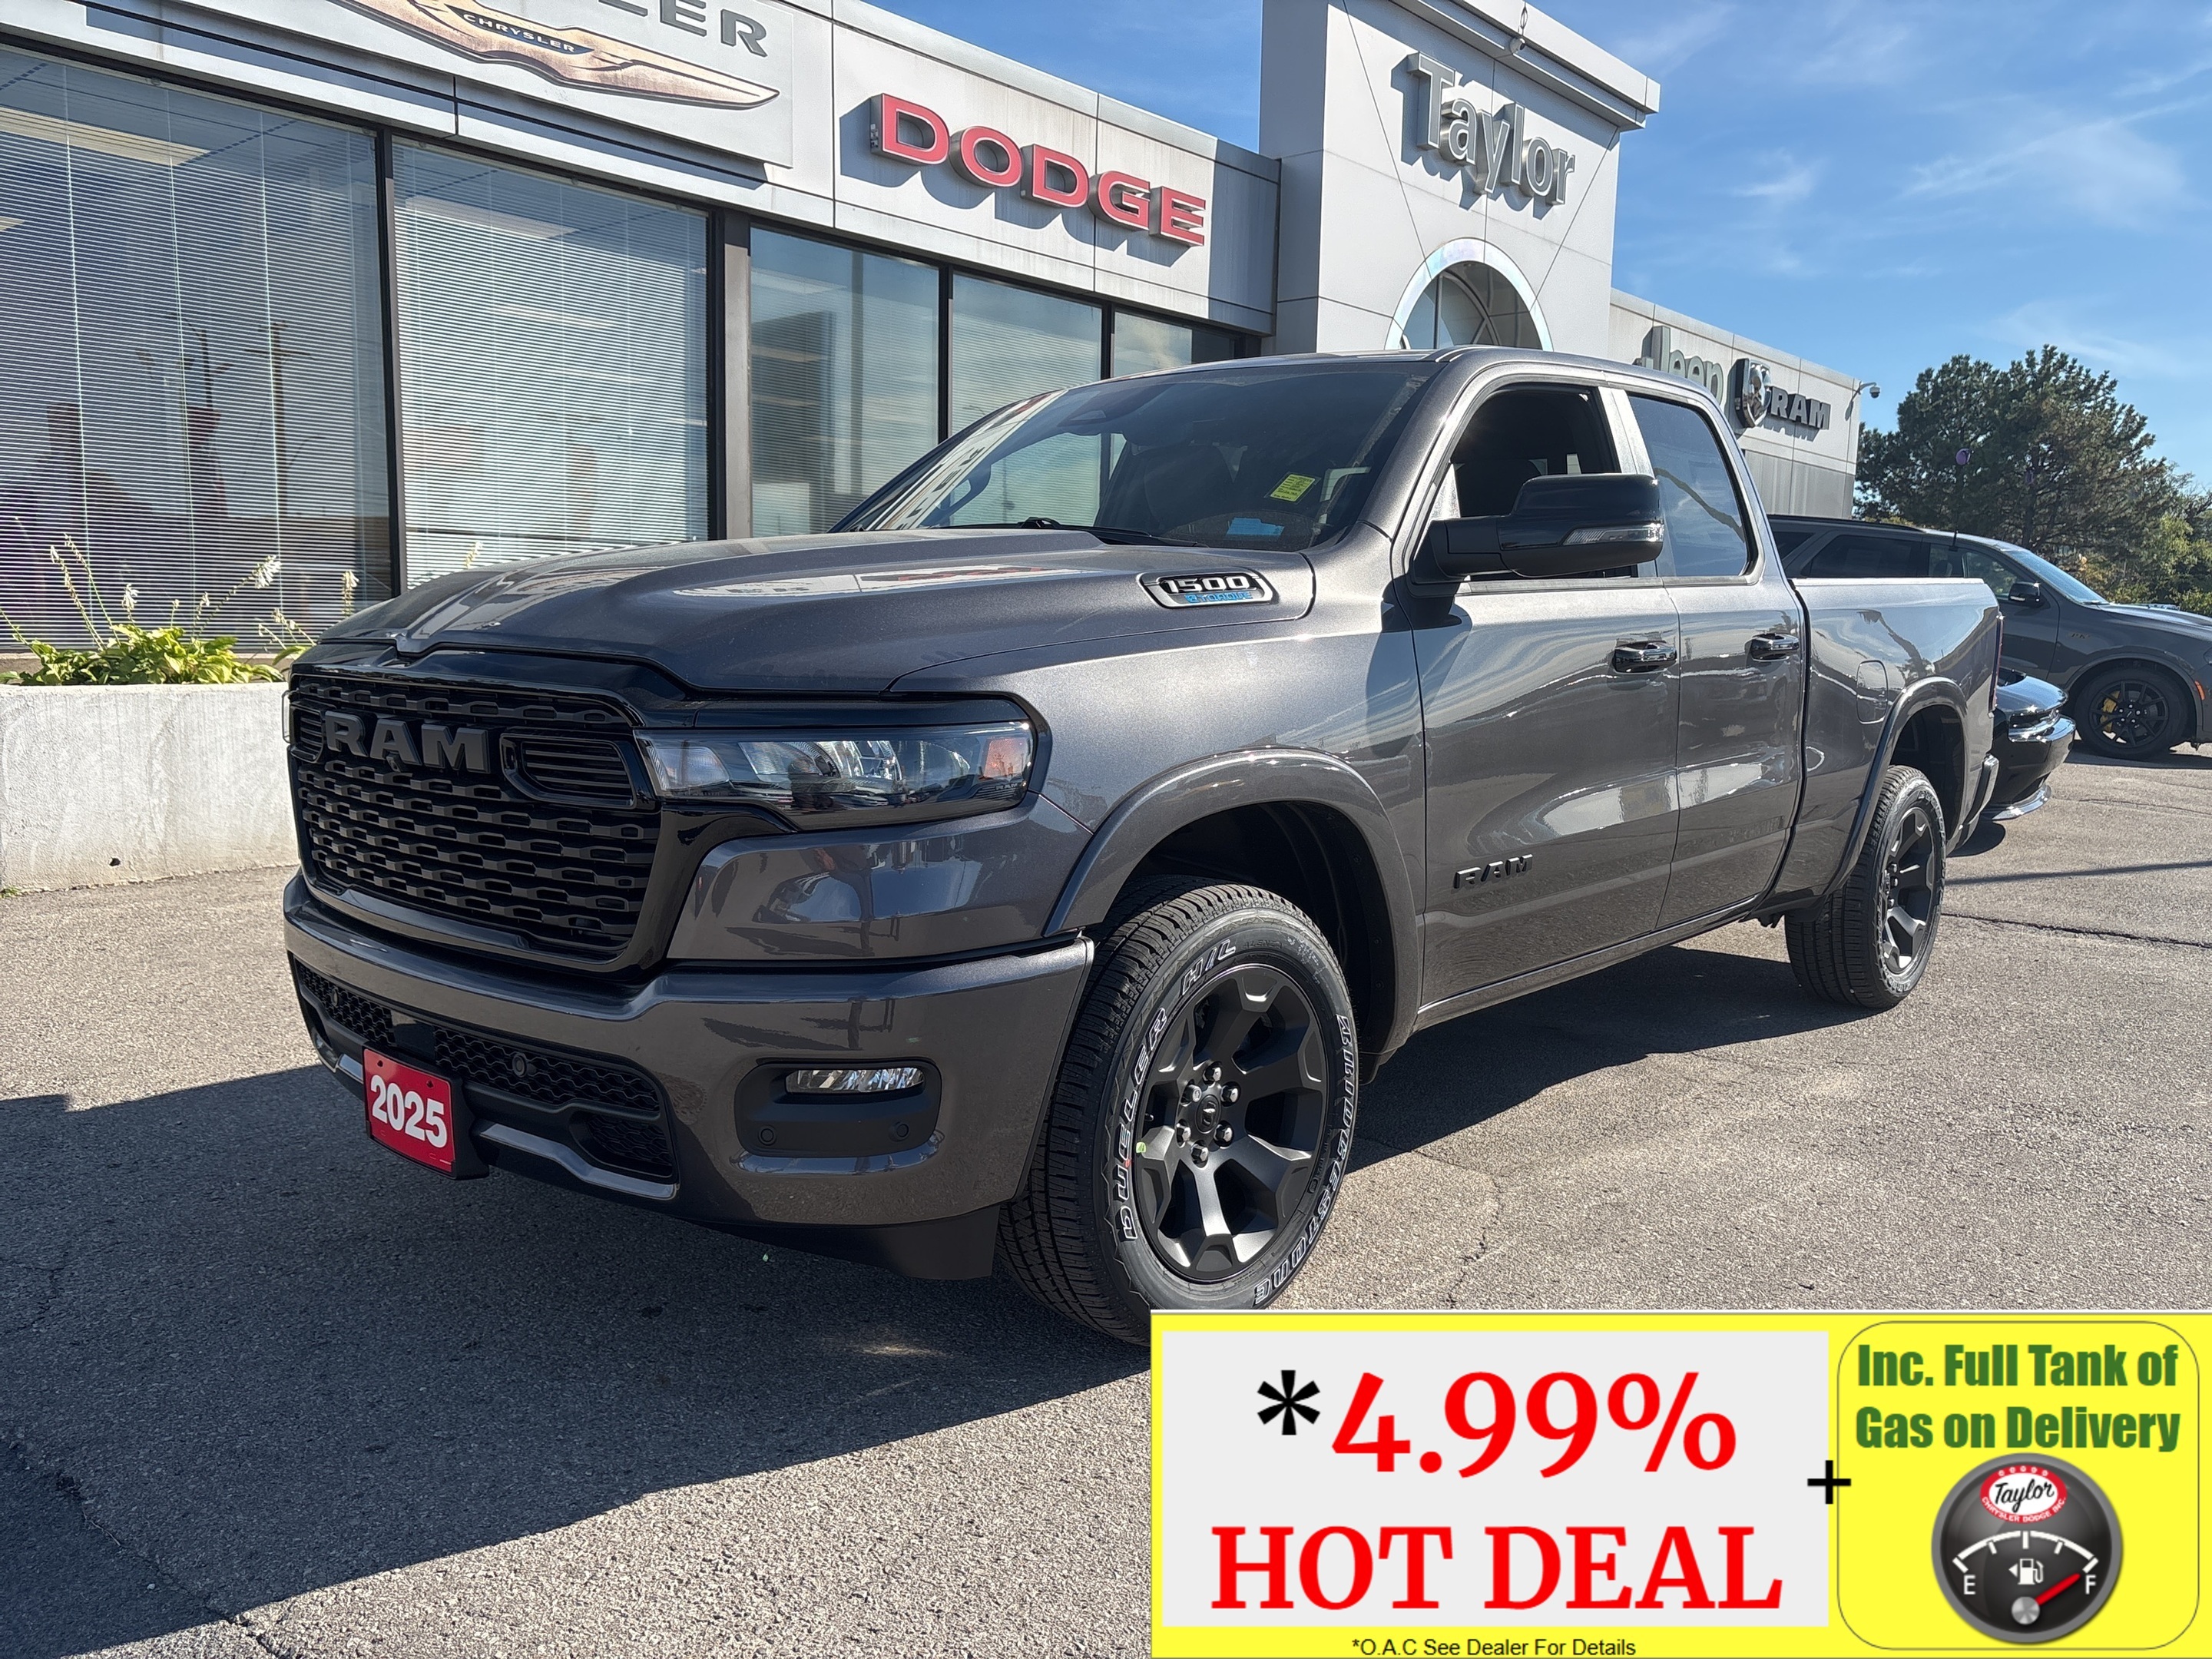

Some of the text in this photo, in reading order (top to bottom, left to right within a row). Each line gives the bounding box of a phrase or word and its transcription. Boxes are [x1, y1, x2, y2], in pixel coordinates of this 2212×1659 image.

[462, 13, 575, 53] CHRYSLER
[598, 0, 767, 58] ER
[1408, 51, 1575, 205] Taylor
[871, 93, 1206, 247] DODGE
[1770, 386, 1831, 430] RAM
[1161, 576, 1250, 594] 1500
[325, 710, 491, 774] RAM
[1453, 853, 1533, 889] RAM
[370, 1074, 448, 1148] 2025
[1118, 1007, 1167, 1240] DUELER
[1182, 939, 1237, 996] H/L
[1254, 1014, 1356, 1305] BRIDGESTONE
